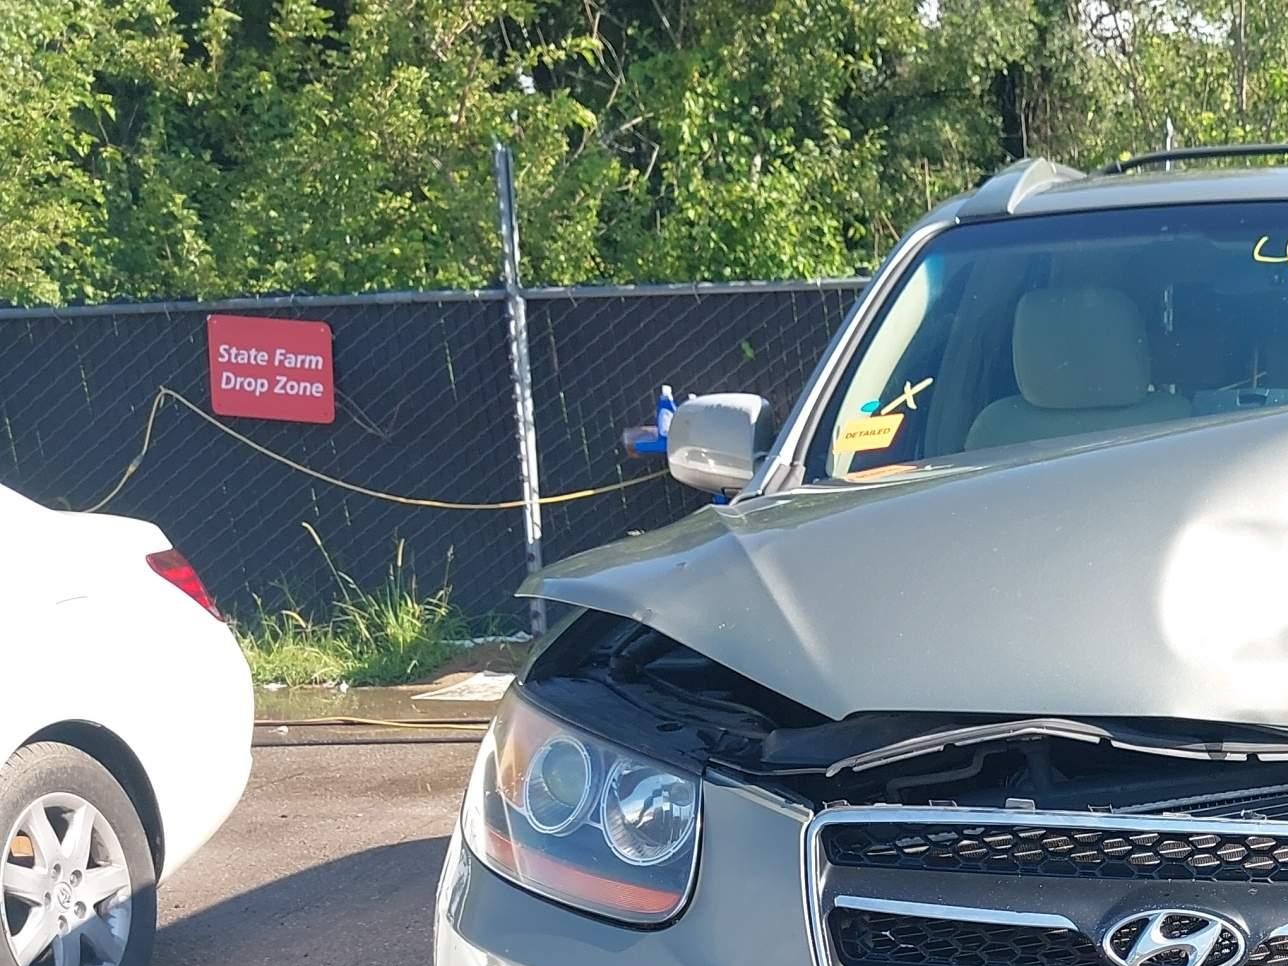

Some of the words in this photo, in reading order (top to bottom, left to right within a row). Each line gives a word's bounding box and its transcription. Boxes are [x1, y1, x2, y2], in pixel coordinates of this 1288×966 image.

[218, 345, 268, 365] State
[275, 349, 323, 369] Farm
[221, 372, 269, 396] Drop
[274, 376, 324, 397] Zone
[845, 427, 891, 439] DETAILED
